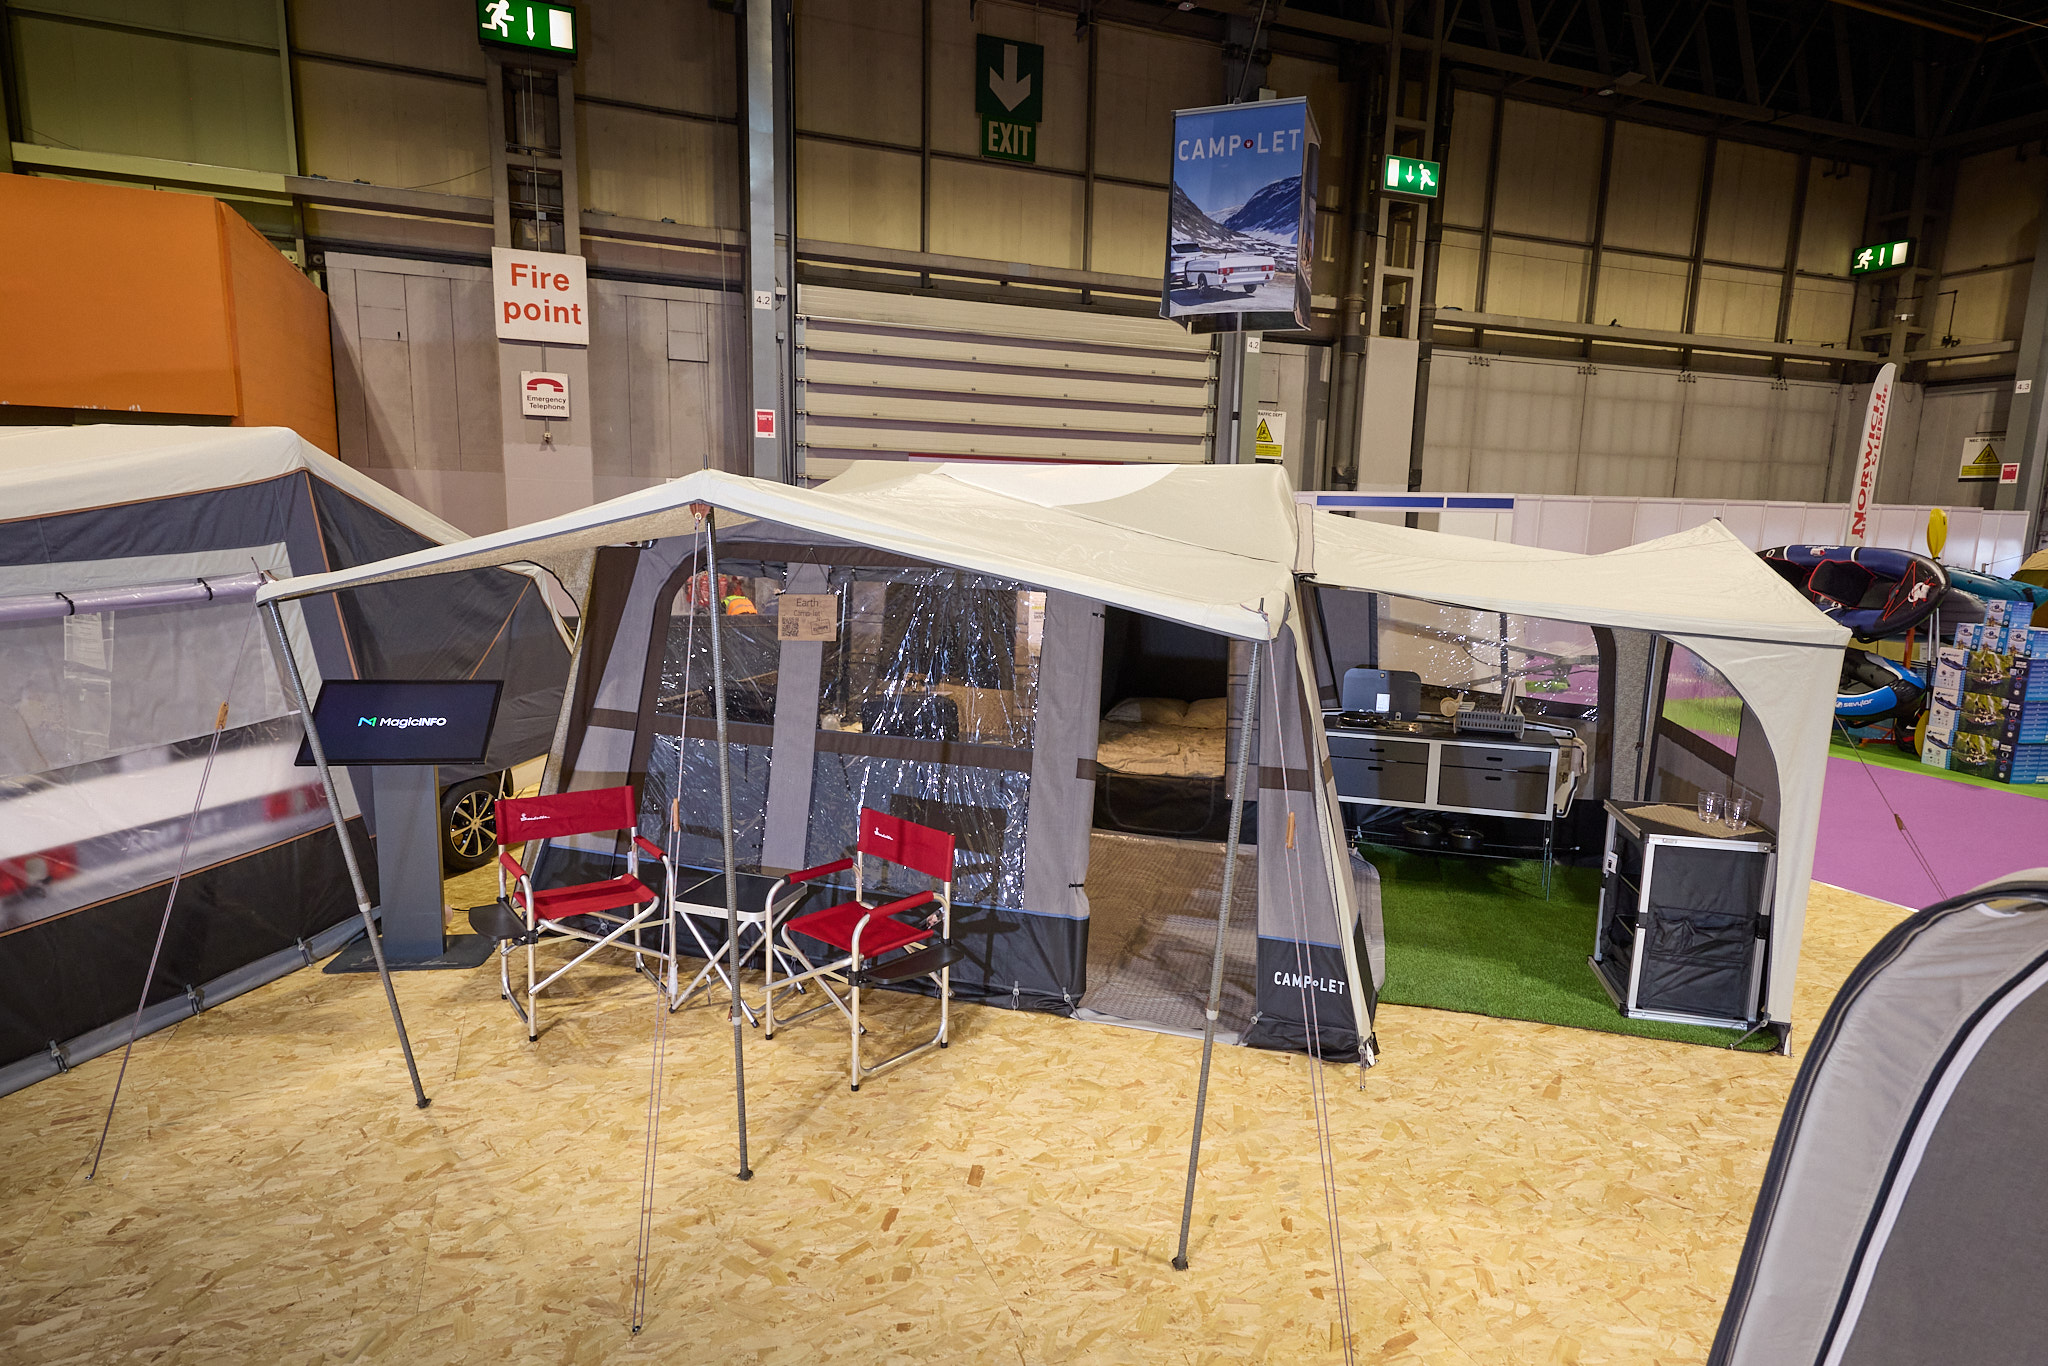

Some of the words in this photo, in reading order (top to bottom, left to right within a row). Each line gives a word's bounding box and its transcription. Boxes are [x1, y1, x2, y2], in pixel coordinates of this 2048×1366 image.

[988, 120, 1032, 156] EXIT
[510, 262, 570, 292] Fire
[756, 295, 771, 305] 4.2
[503, 298, 582, 325] point
[1248, 341, 1259, 349] 4.2
[526, 394, 567, 404] Emergency
[529, 402, 566, 410] Telephone
[1874, 384, 1888, 450] LEISURE
[1851, 392, 1883, 536] NORWICH
[796, 597, 819, 607] Earth
[1843, 698, 1874, 708] sevylor
[379, 716, 447, 729] MagicINFO
